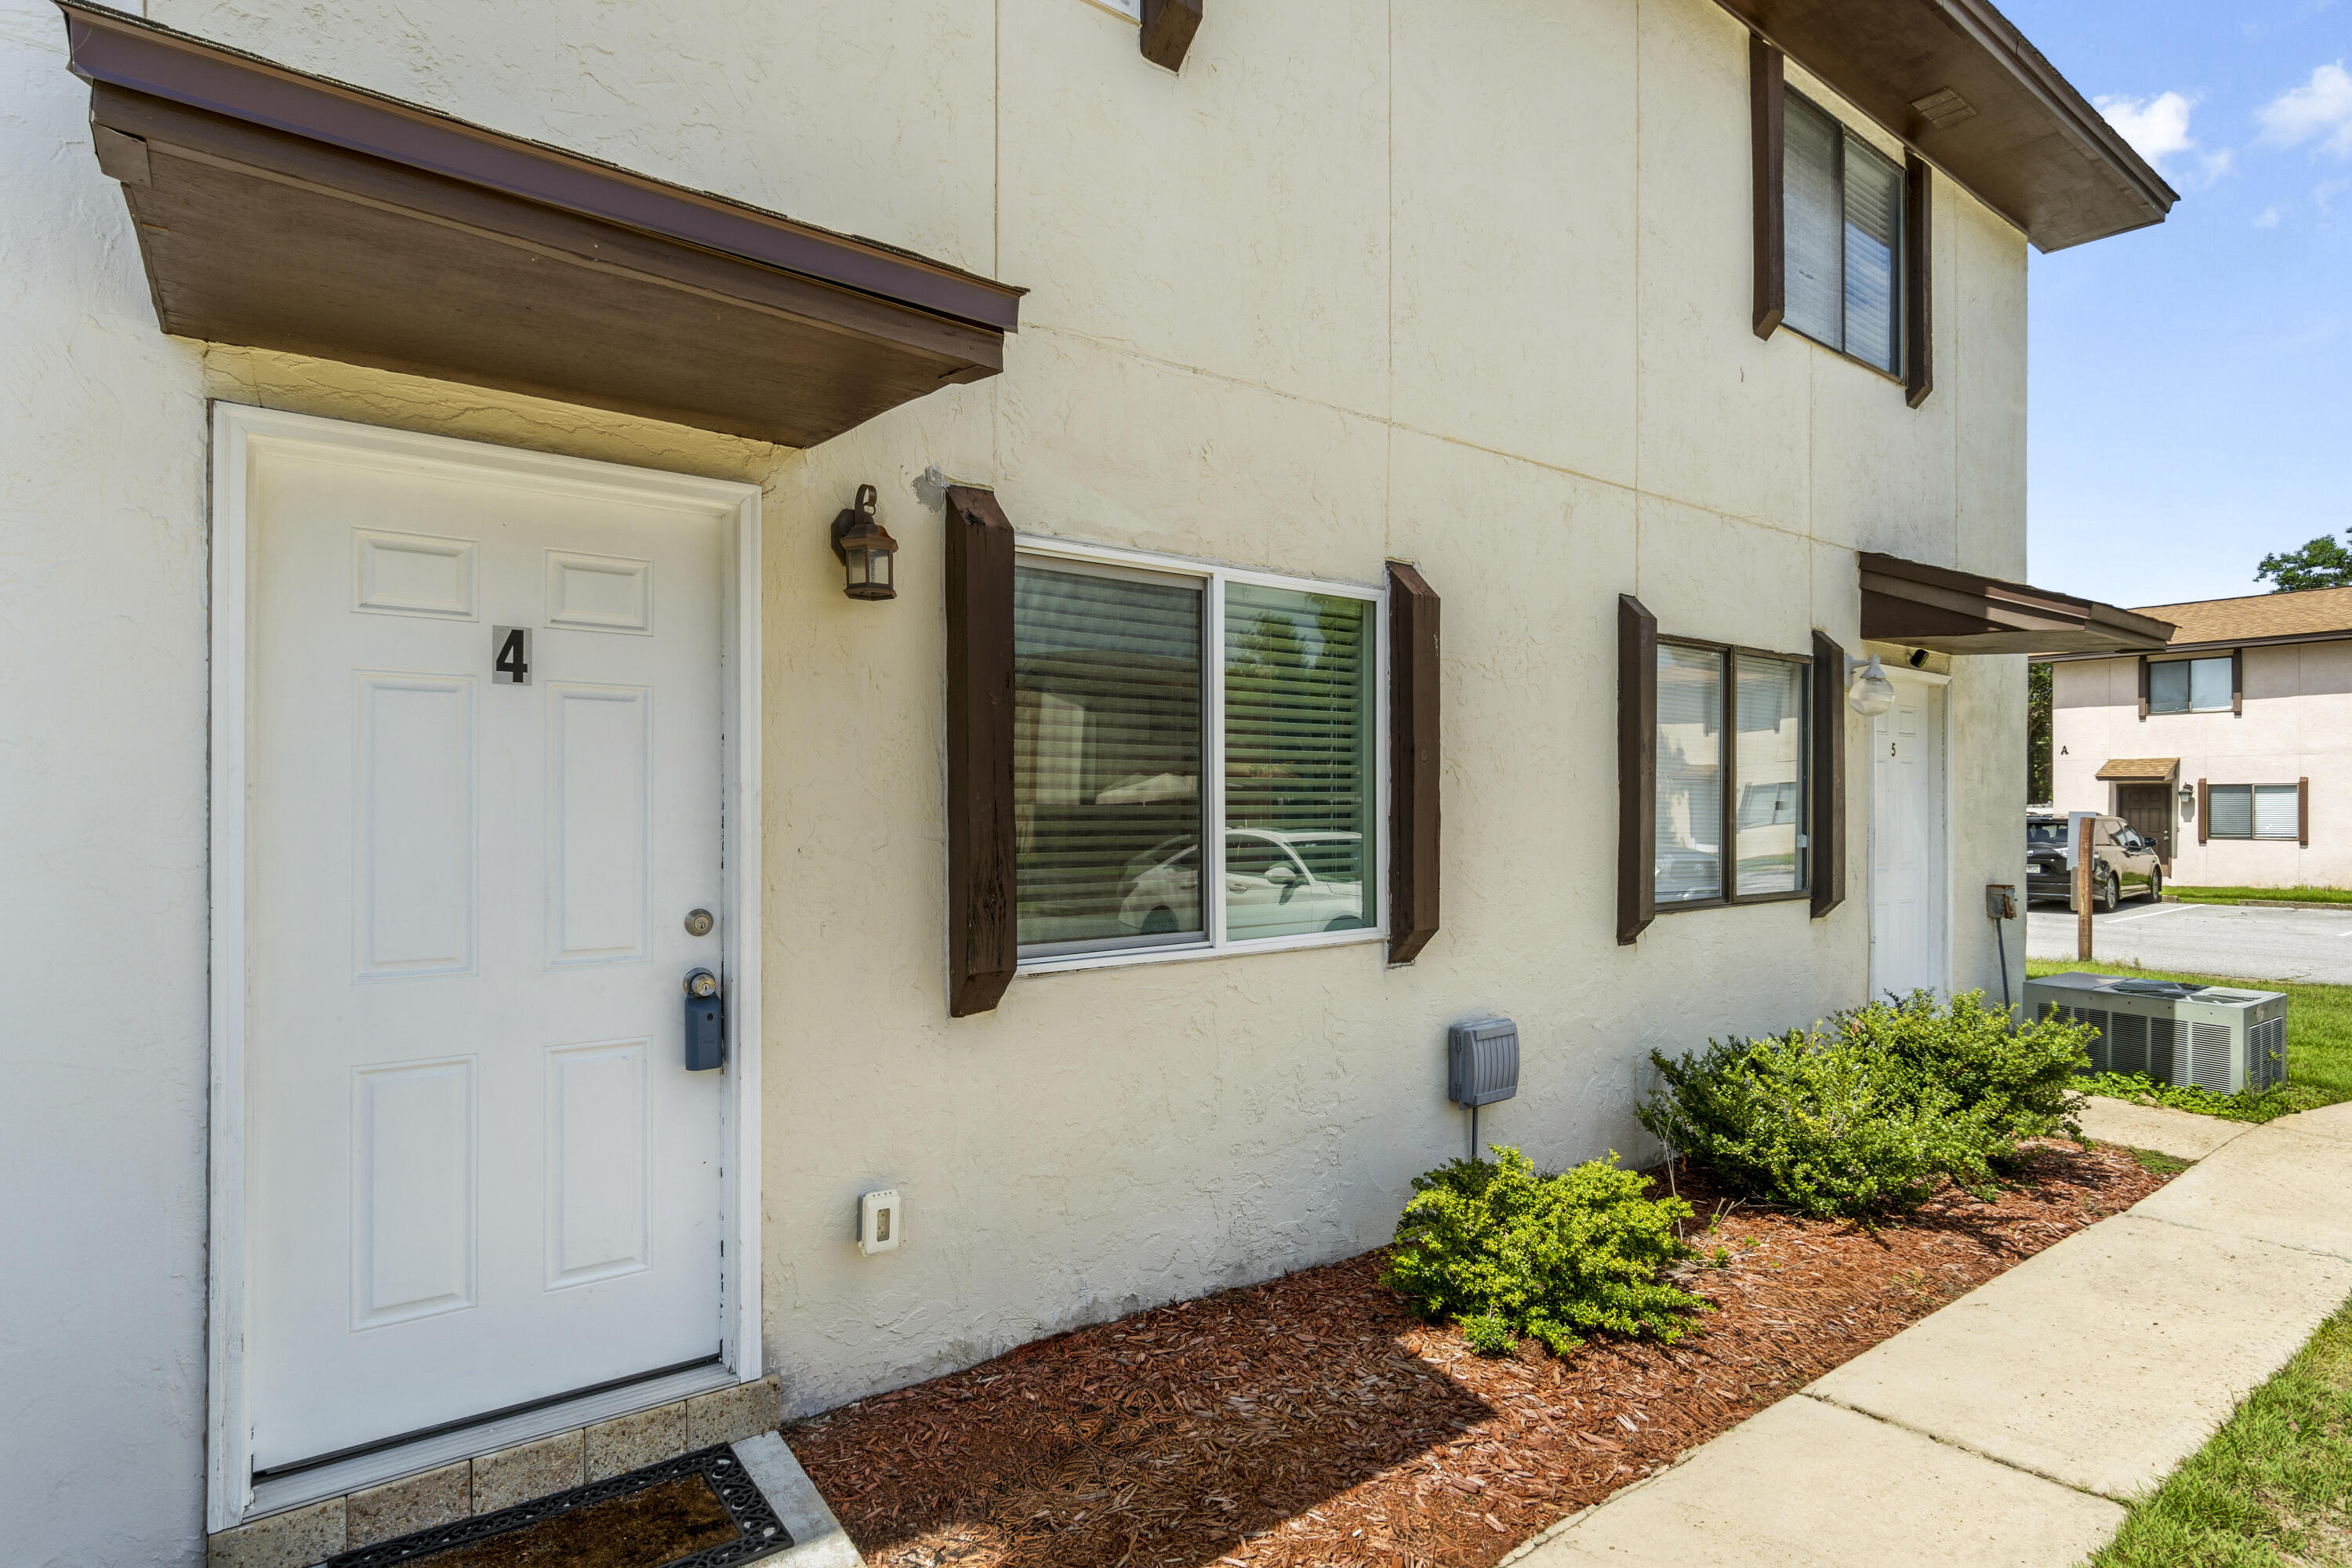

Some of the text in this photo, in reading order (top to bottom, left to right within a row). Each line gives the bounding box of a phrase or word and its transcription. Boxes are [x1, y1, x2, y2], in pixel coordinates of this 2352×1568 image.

[496, 629, 528, 683] 4
[1891, 742, 1896, 757] 5
[2060, 745, 2069, 755] A
